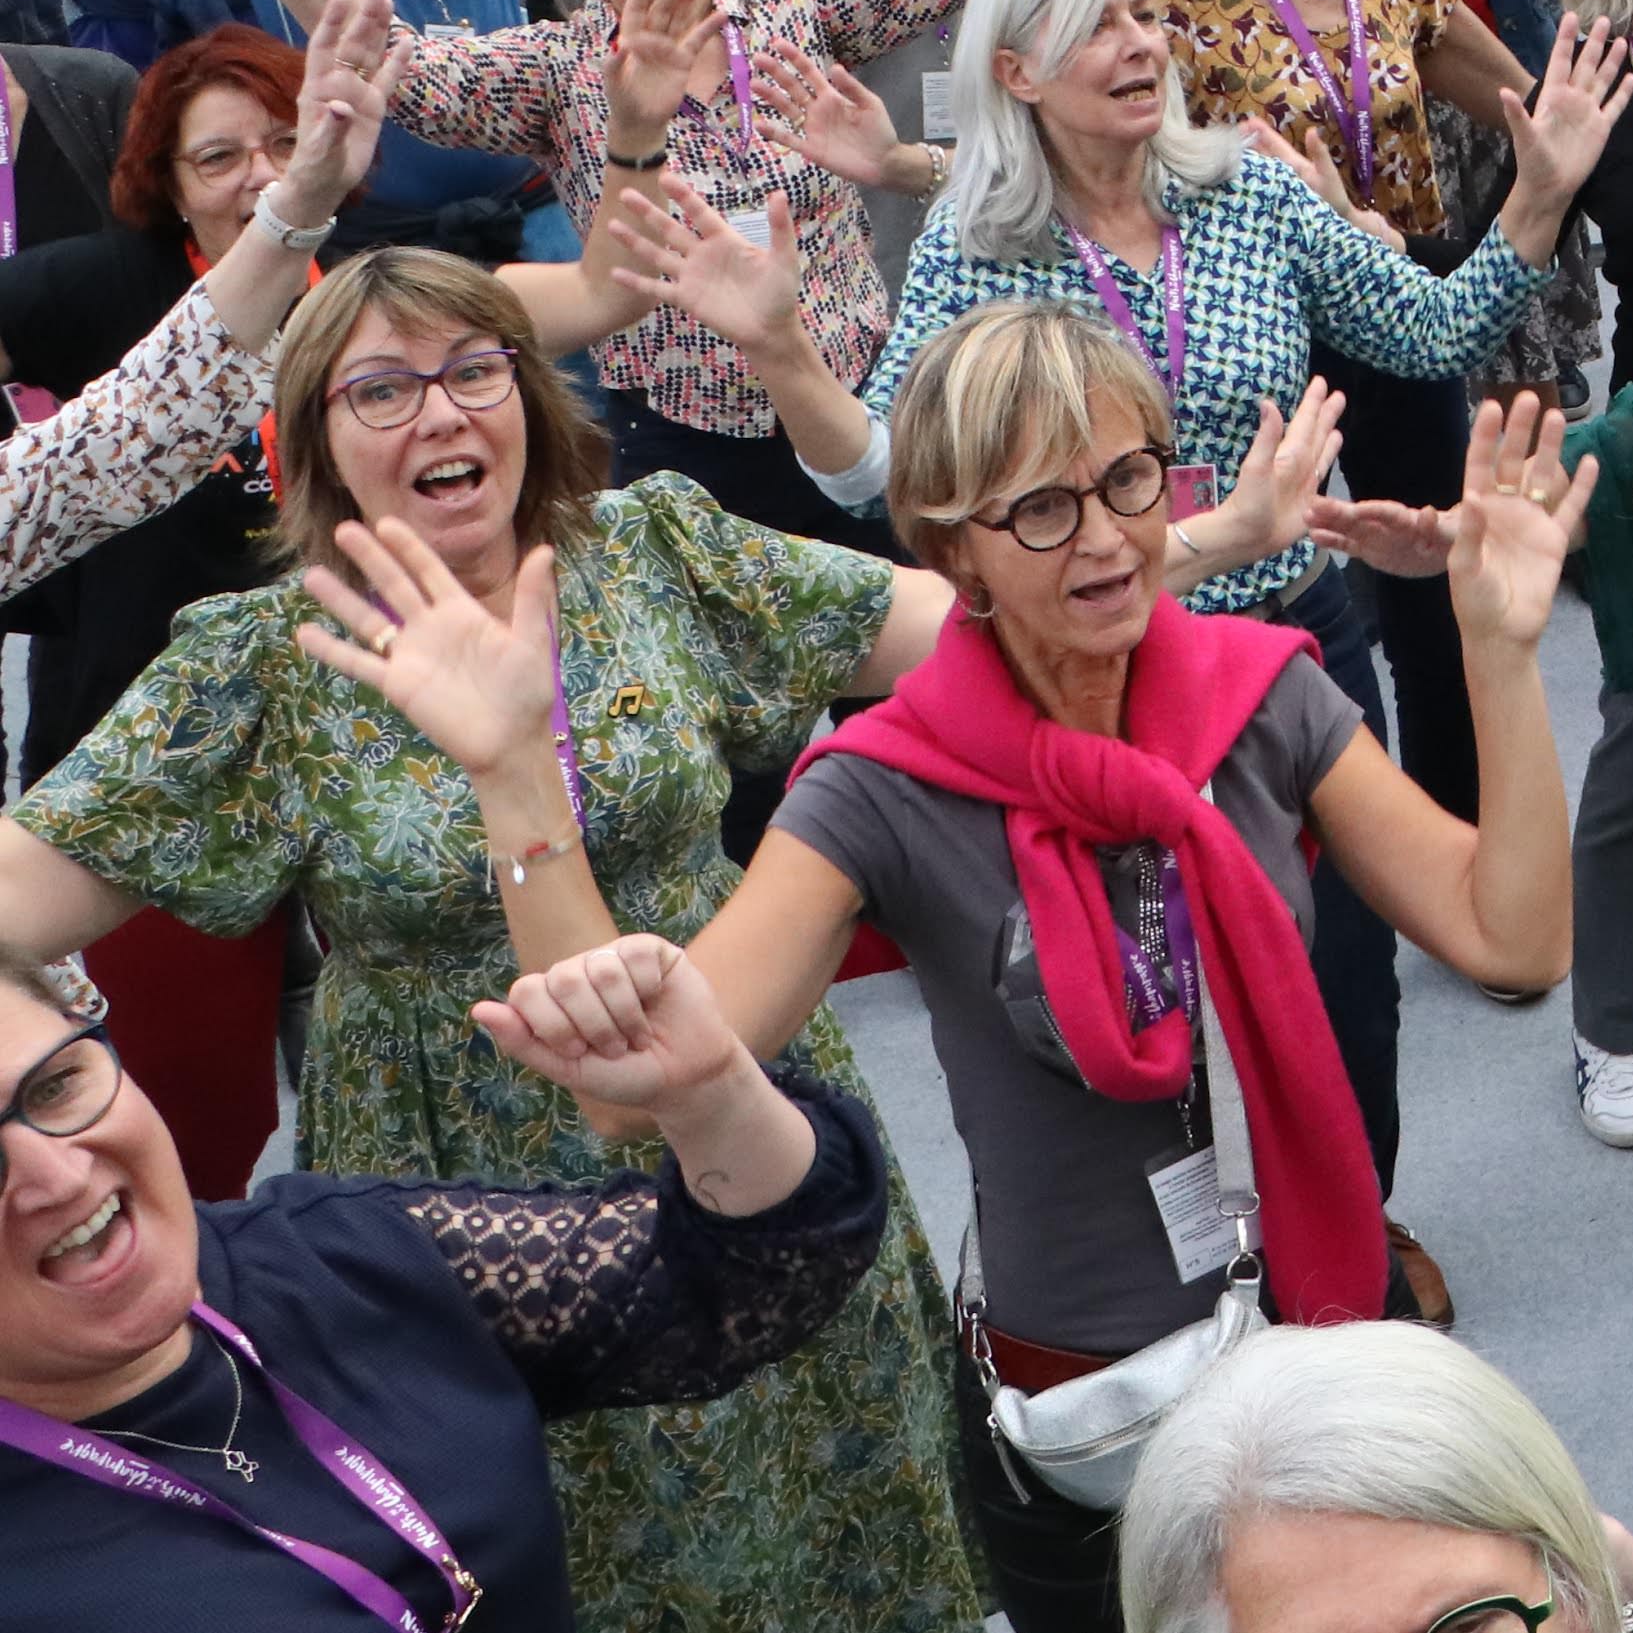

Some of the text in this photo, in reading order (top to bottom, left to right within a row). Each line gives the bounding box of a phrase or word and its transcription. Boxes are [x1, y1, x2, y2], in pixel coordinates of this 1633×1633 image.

[244, 479, 274, 494] CO
[58, 1441, 148, 1483] Champagne
[334, 1449, 400, 1511] Champagne
[399, 1510, 437, 1552] Nuits
